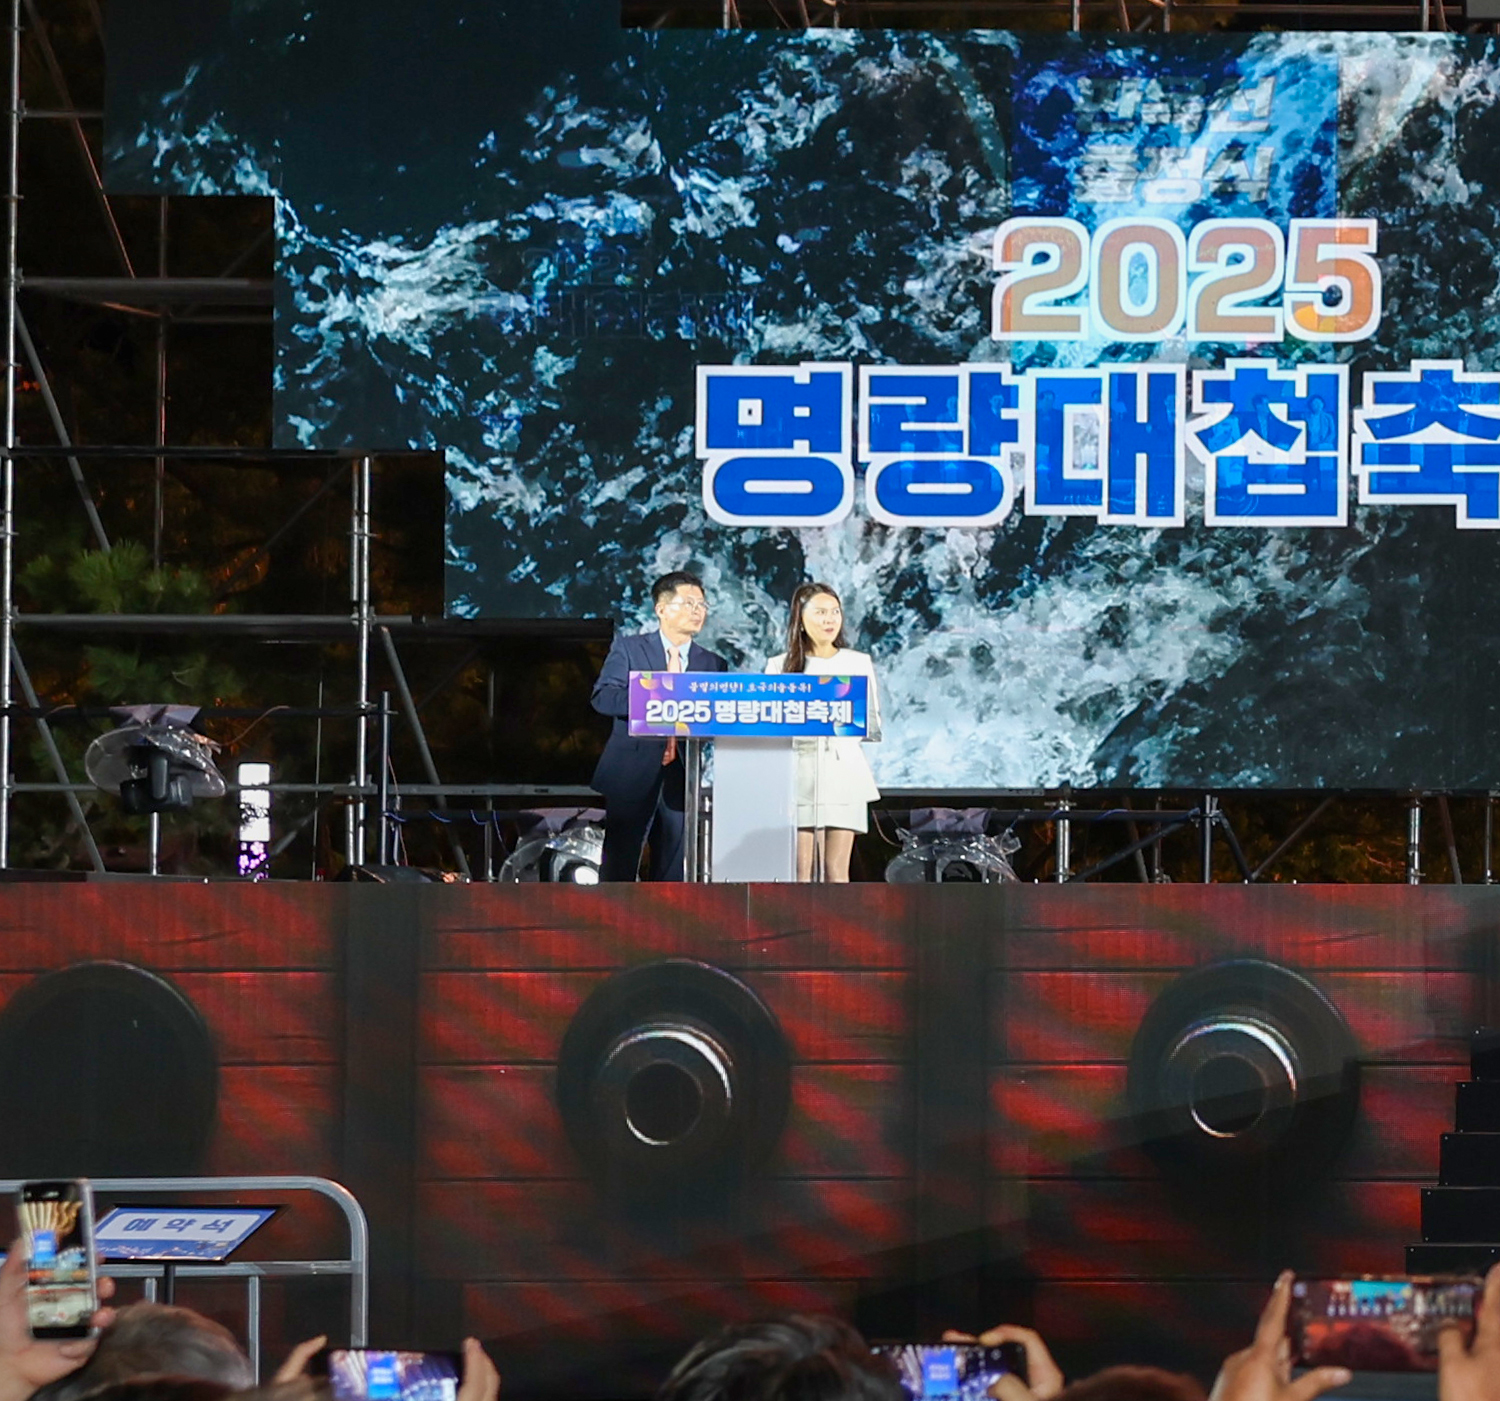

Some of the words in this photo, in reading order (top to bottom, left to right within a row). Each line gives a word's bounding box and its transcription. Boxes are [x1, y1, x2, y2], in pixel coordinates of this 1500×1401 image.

[992, 216, 1382, 342] 2025
[645, 700, 711, 723] 2025
[714, 700, 852, 724] 명량대첩축제
